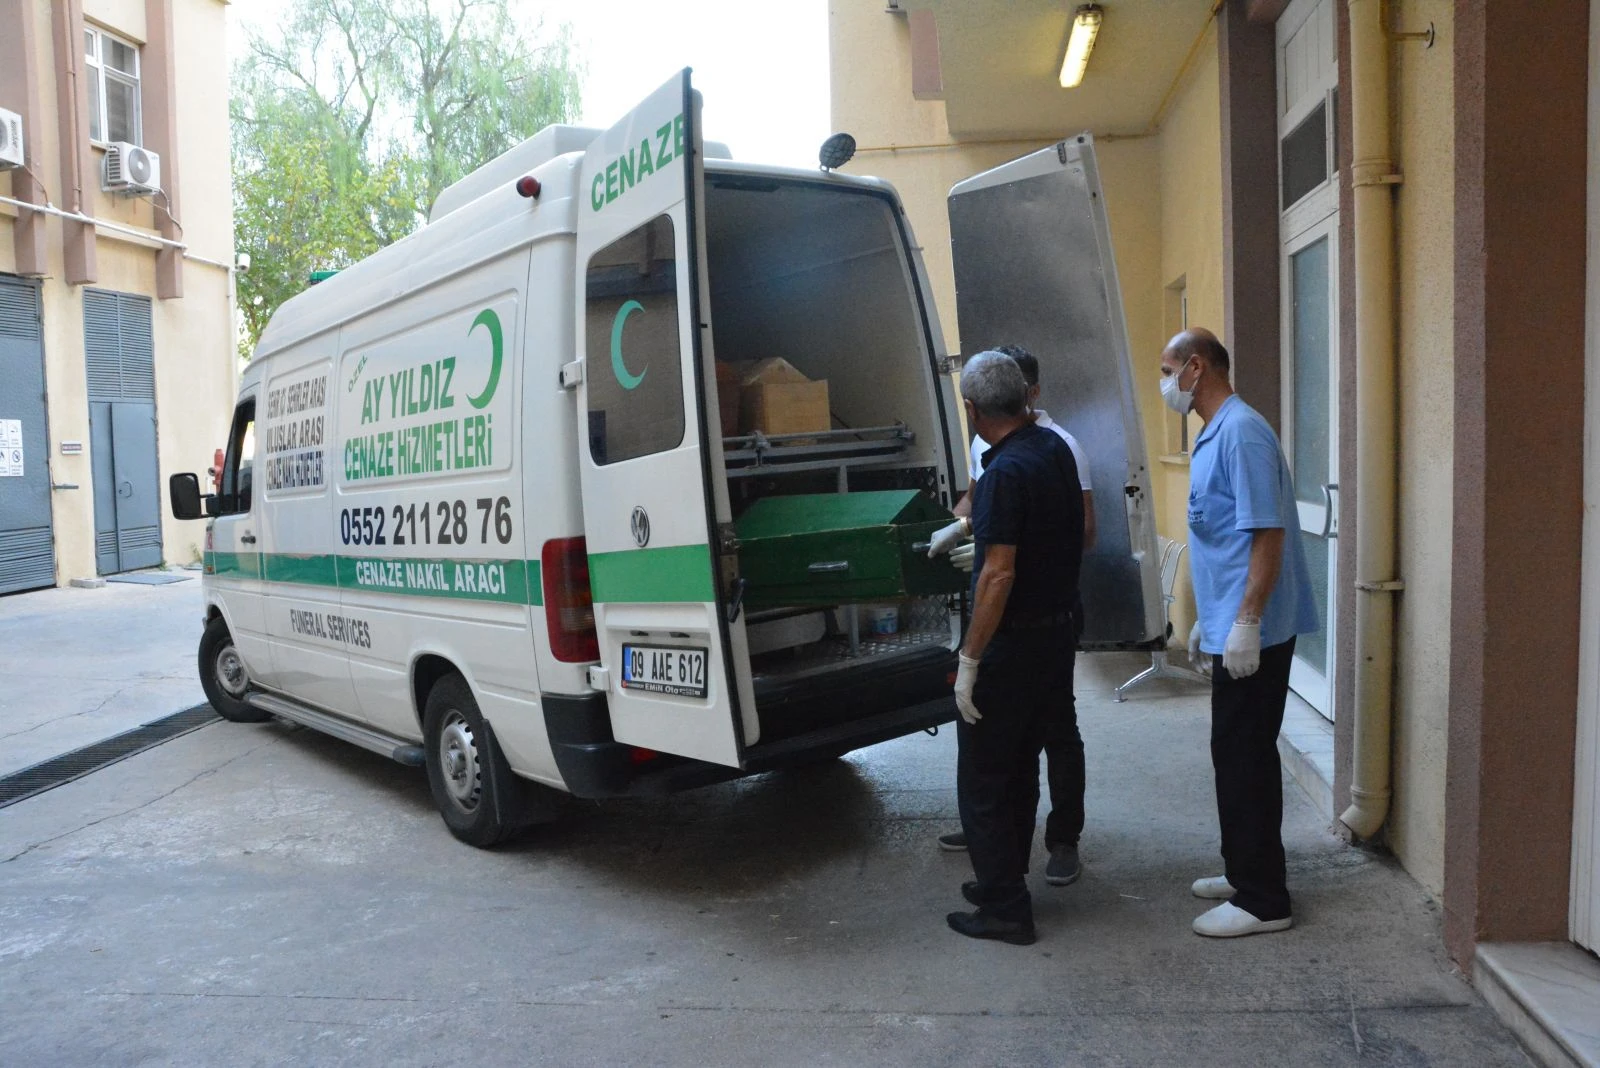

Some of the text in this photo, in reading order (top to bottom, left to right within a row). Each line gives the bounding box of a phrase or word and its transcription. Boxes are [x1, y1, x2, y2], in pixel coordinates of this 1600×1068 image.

[591, 112, 684, 212] CENAZE
[361, 356, 456, 425] AY YILDIZ
[267, 415, 324, 454] ULUSLAR ARASI
[344, 431, 394, 481] CENAZE
[341, 496, 512, 545] 0552 211 28 76
[356, 561, 404, 587] CENAZE
[454, 564, 506, 594] ARACI
[290, 609, 327, 639] FUNERAL
[631, 651, 702, 684] 09 AAE 612
